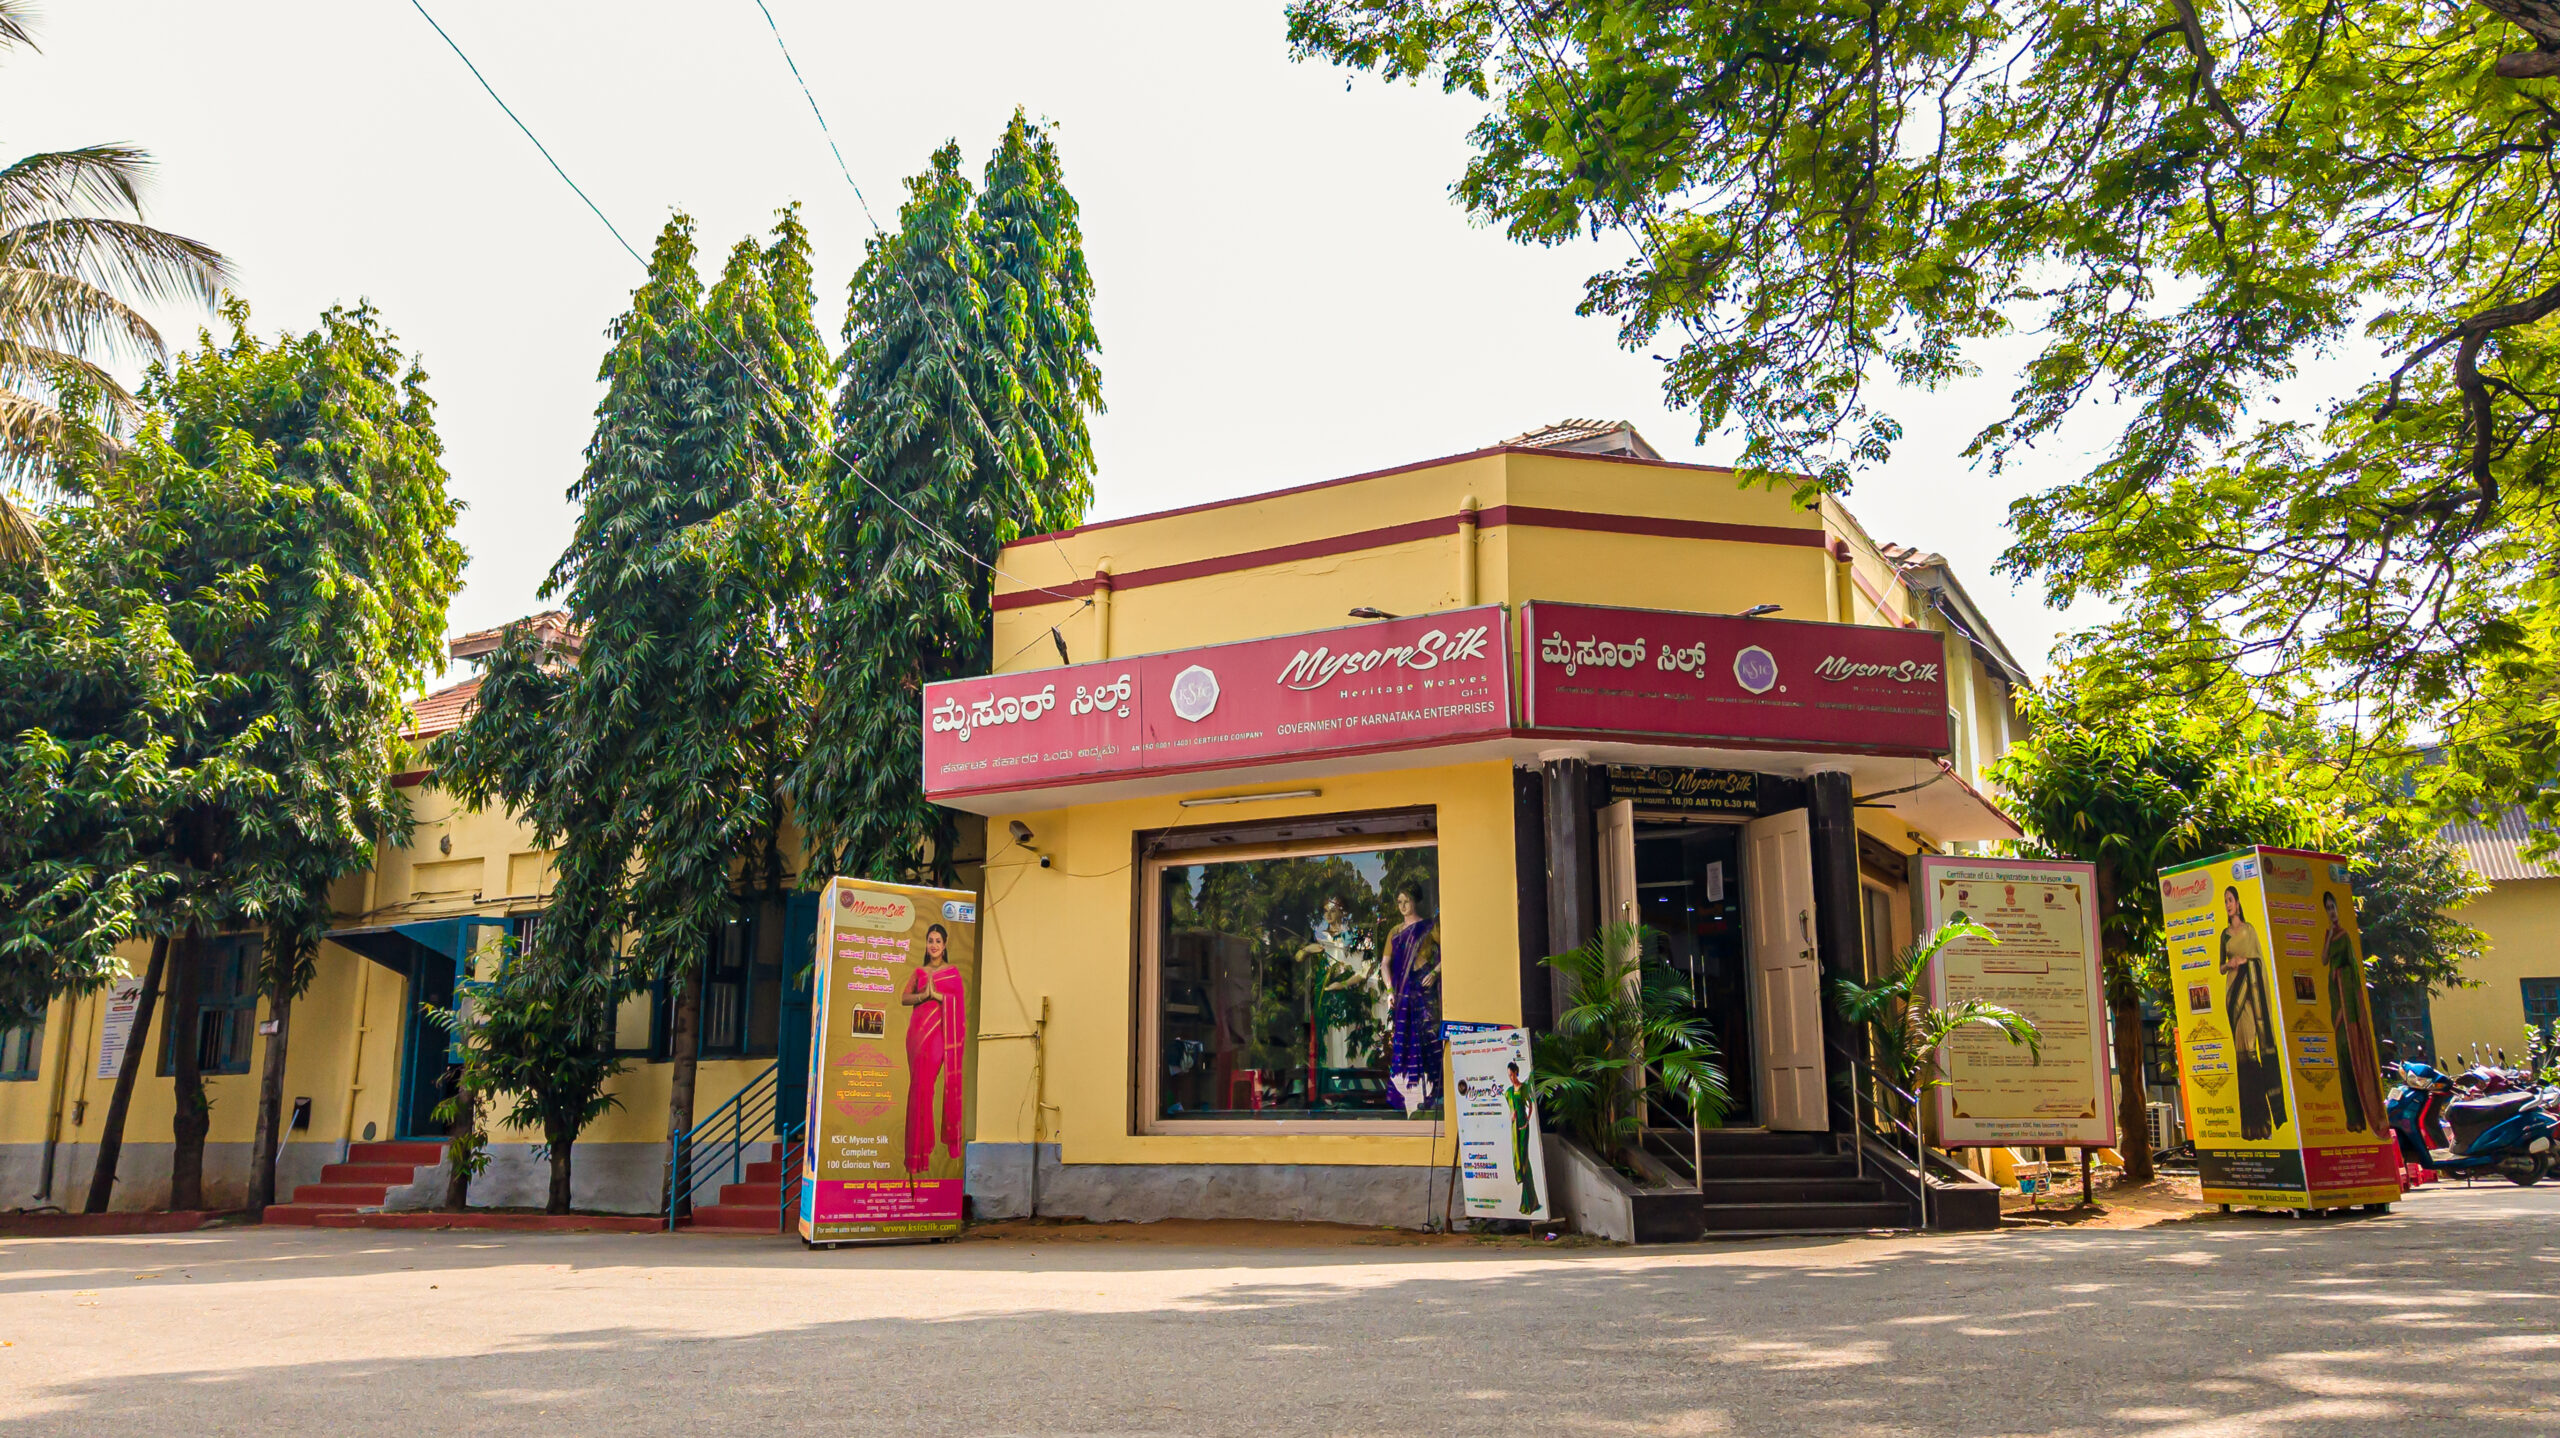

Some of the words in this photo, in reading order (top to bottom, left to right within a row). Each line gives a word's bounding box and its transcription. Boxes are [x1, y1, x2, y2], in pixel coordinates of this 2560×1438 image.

[1542, 631, 1646, 677] ಮೈಸೂರ್
[1657, 642, 1706, 679] ಸಿಲ್ಕ್
[1742, 661, 1771, 680] KSIC
[1340, 684, 1414, 698] Heritage
[1423, 674, 1488, 689] Weaves
[1461, 688, 1488, 698] GI-11
[932, 684, 1056, 742] ಮೈಸೂರ್
[1070, 674, 1131, 718] ಸಿಲ್ಕ್
[1277, 718, 1343, 736] GOVERNMENT
[1345, 716, 1358, 728] OF
[1361, 710, 1421, 726] KARNATAKA
[1423, 701, 1495, 719] ENTERPRISES
[1142, 743, 1154, 751] ISO
[1193, 735, 1229, 745] CERTIFIED
[1230, 731, 1263, 740] COMPANY
[992, 754, 1039, 768] ಸರ್ಕಾರದ
[1043, 750, 1073, 762] ಒಂದು
[1711, 799, 1722, 807] TO
[1724, 799, 1741, 808] 6.30
[1946, 870, 1976, 879] Certificate
[1977, 871, 1984, 879] of
[1996, 872, 2029, 882] Registration
[2030, 873, 2039, 881] for
[2040, 875, 2062, 884] Mysore
[831, 1135, 848, 1144] KSIC
[849, 1135, 875, 1146] Mysore
[876, 1135, 889, 1144] Silk
[841, 1148, 878, 1158] Completes
[827, 1160, 840, 1169] 100
[841, 1160, 871, 1169] Glorious
[872, 1160, 891, 1169] Years
[882, 1222, 957, 1233] www.ksicsilk.com
